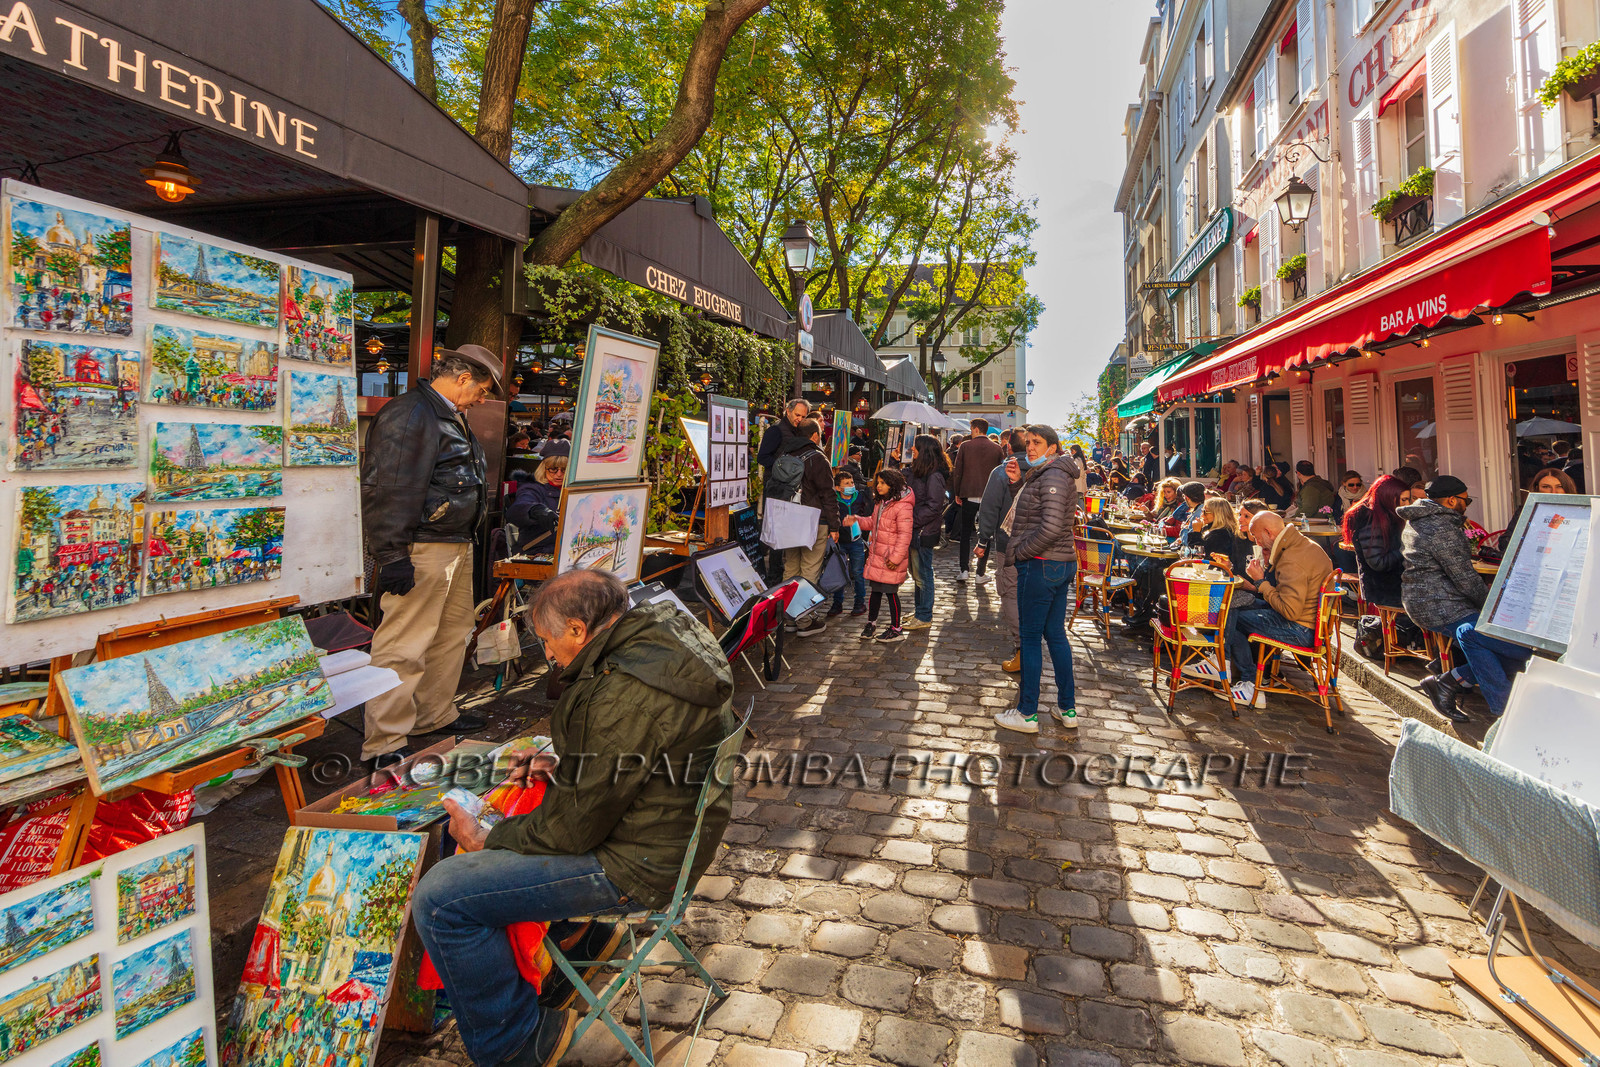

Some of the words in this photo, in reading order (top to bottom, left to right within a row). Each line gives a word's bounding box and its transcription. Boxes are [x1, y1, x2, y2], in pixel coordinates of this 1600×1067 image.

[646, 265, 687, 301] CHEZ
[693, 285, 742, 323] EUGENE
[1380, 310, 1404, 332] BAR
[1406, 307, 1415, 324] A
[1417, 293, 1447, 320] VINS
[28, 825, 49, 834] ART
[15, 845, 49, 858] LOVE
[16, 862, 42, 873] LOVE
